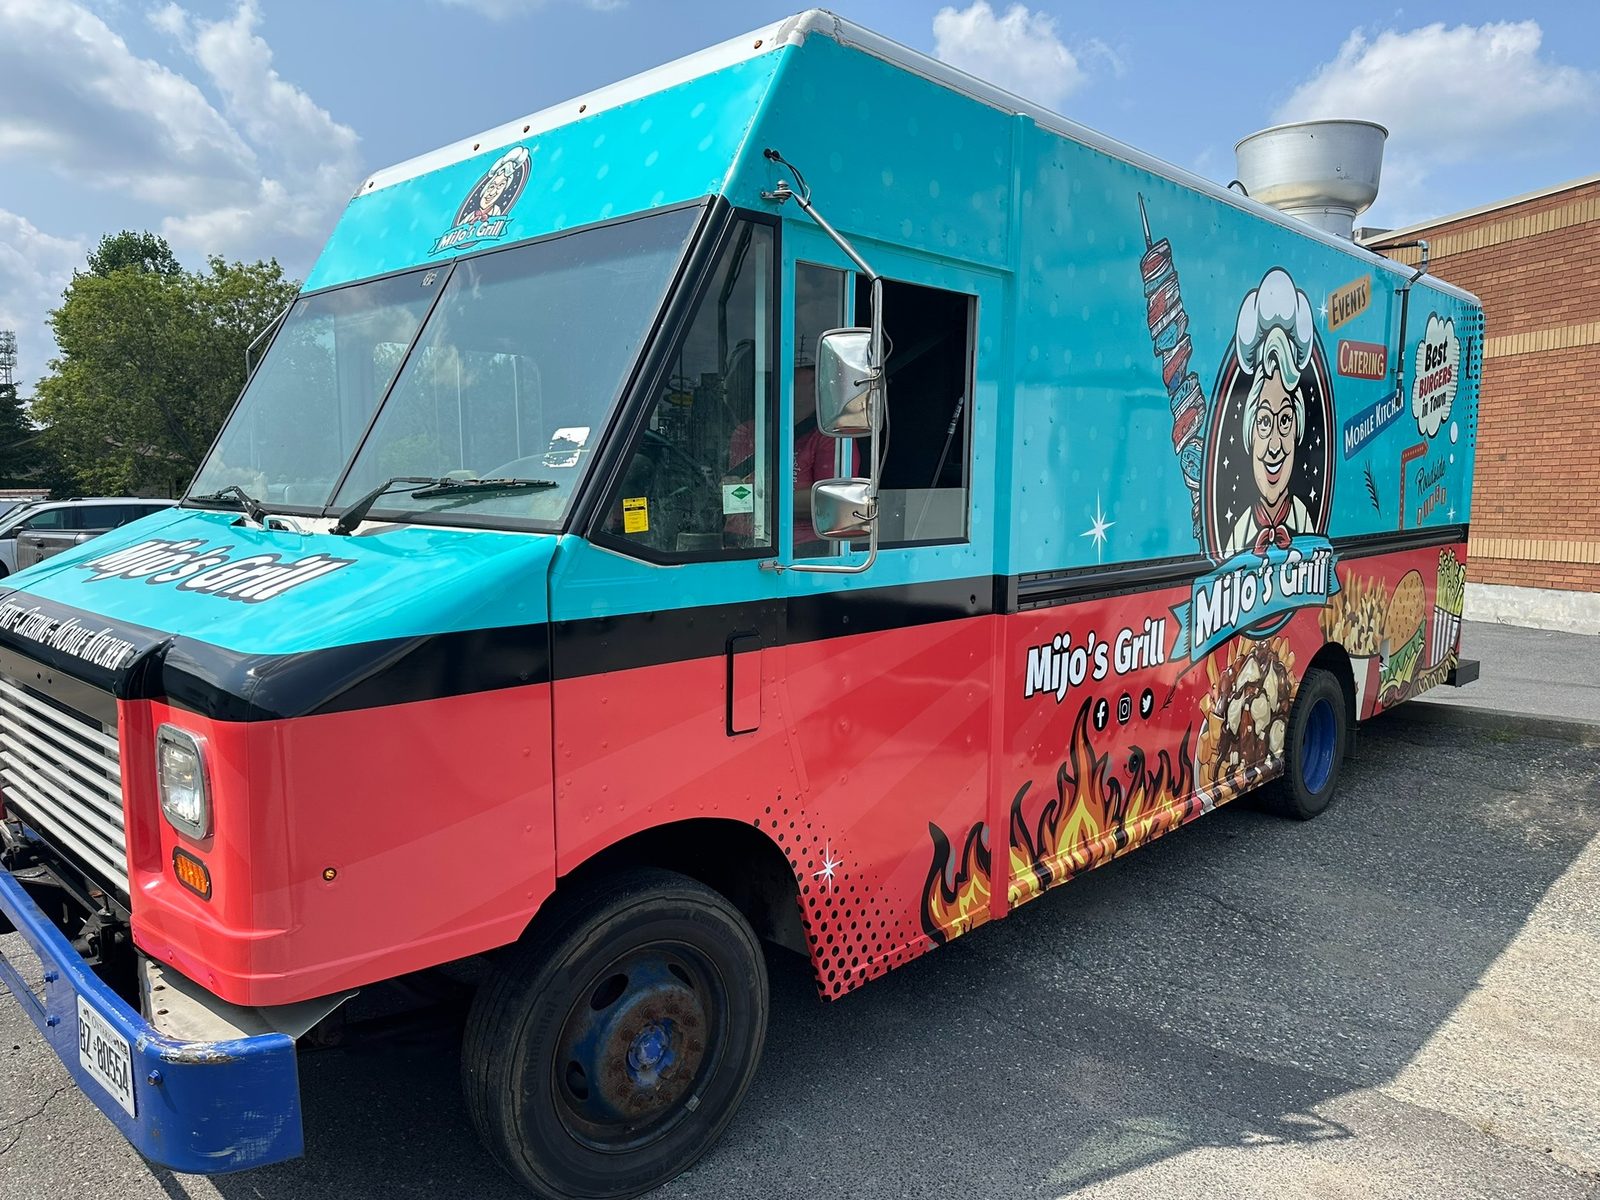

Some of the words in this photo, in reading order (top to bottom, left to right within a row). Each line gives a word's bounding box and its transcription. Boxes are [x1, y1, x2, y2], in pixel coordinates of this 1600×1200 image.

[476, 220, 504, 237] Grill
[1425, 337, 1448, 372] Best
[1419, 364, 1452, 399] BURGERS
[180, 554, 352, 602] Grill
[1280, 550, 1332, 597] Grill
[1024, 632, 1109, 703] Mijo's
[1114, 618, 1166, 674] Grill
[80, 1016, 94, 1062] BZ
[97, 1034, 130, 1098] 80554
